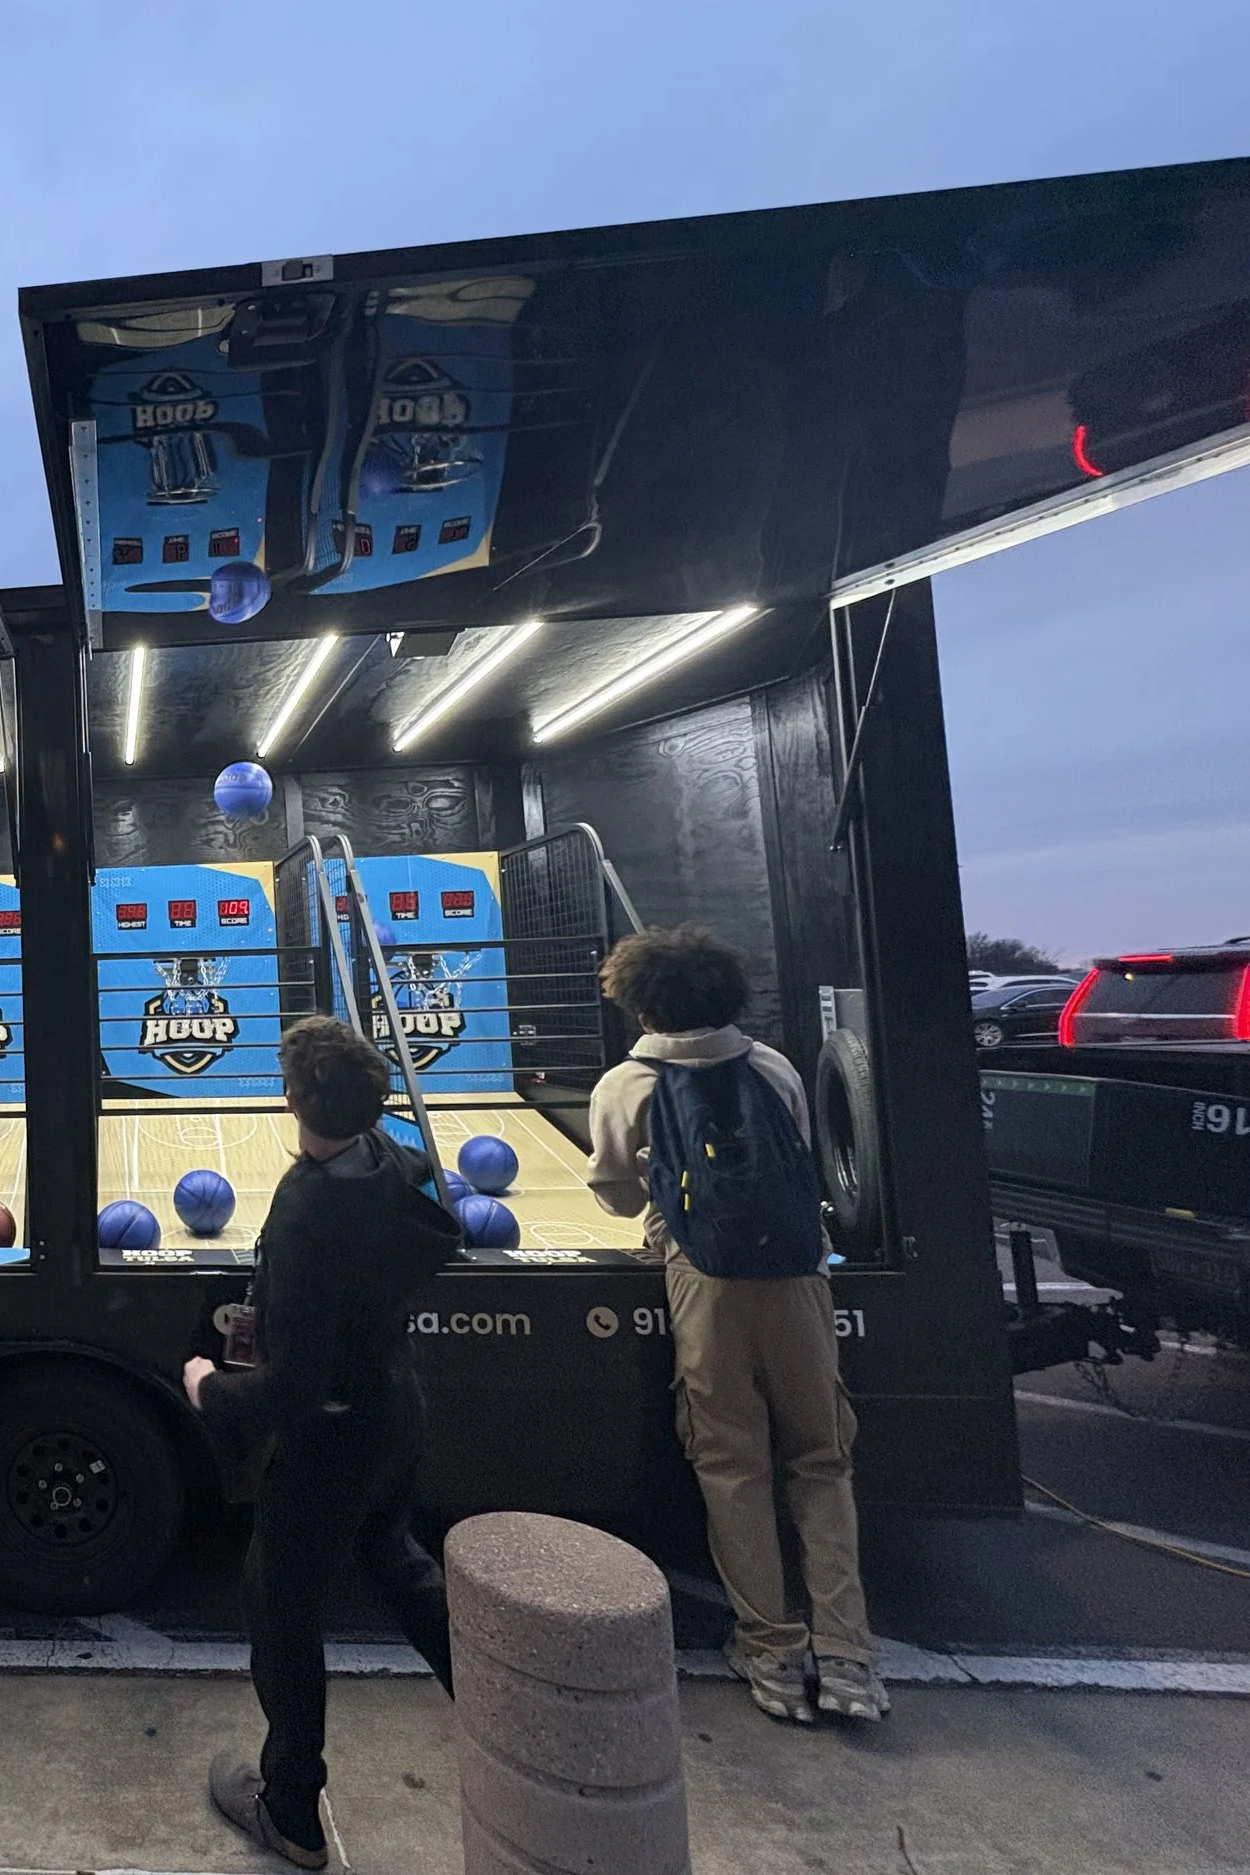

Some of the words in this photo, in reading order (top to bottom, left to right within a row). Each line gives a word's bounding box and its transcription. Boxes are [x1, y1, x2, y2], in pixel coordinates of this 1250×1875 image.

[223, 901, 248, 915] 109
[444, 909, 472, 917] SCORE
[117, 920, 146, 929] HIGHEST
[220, 917, 248, 925] SCORE
[144, 1018, 235, 1046] HOOP
[122, 1249, 193, 1257] HOOP
[503, 1249, 582, 1257] HOOP
[632, 1307, 668, 1337] 91
